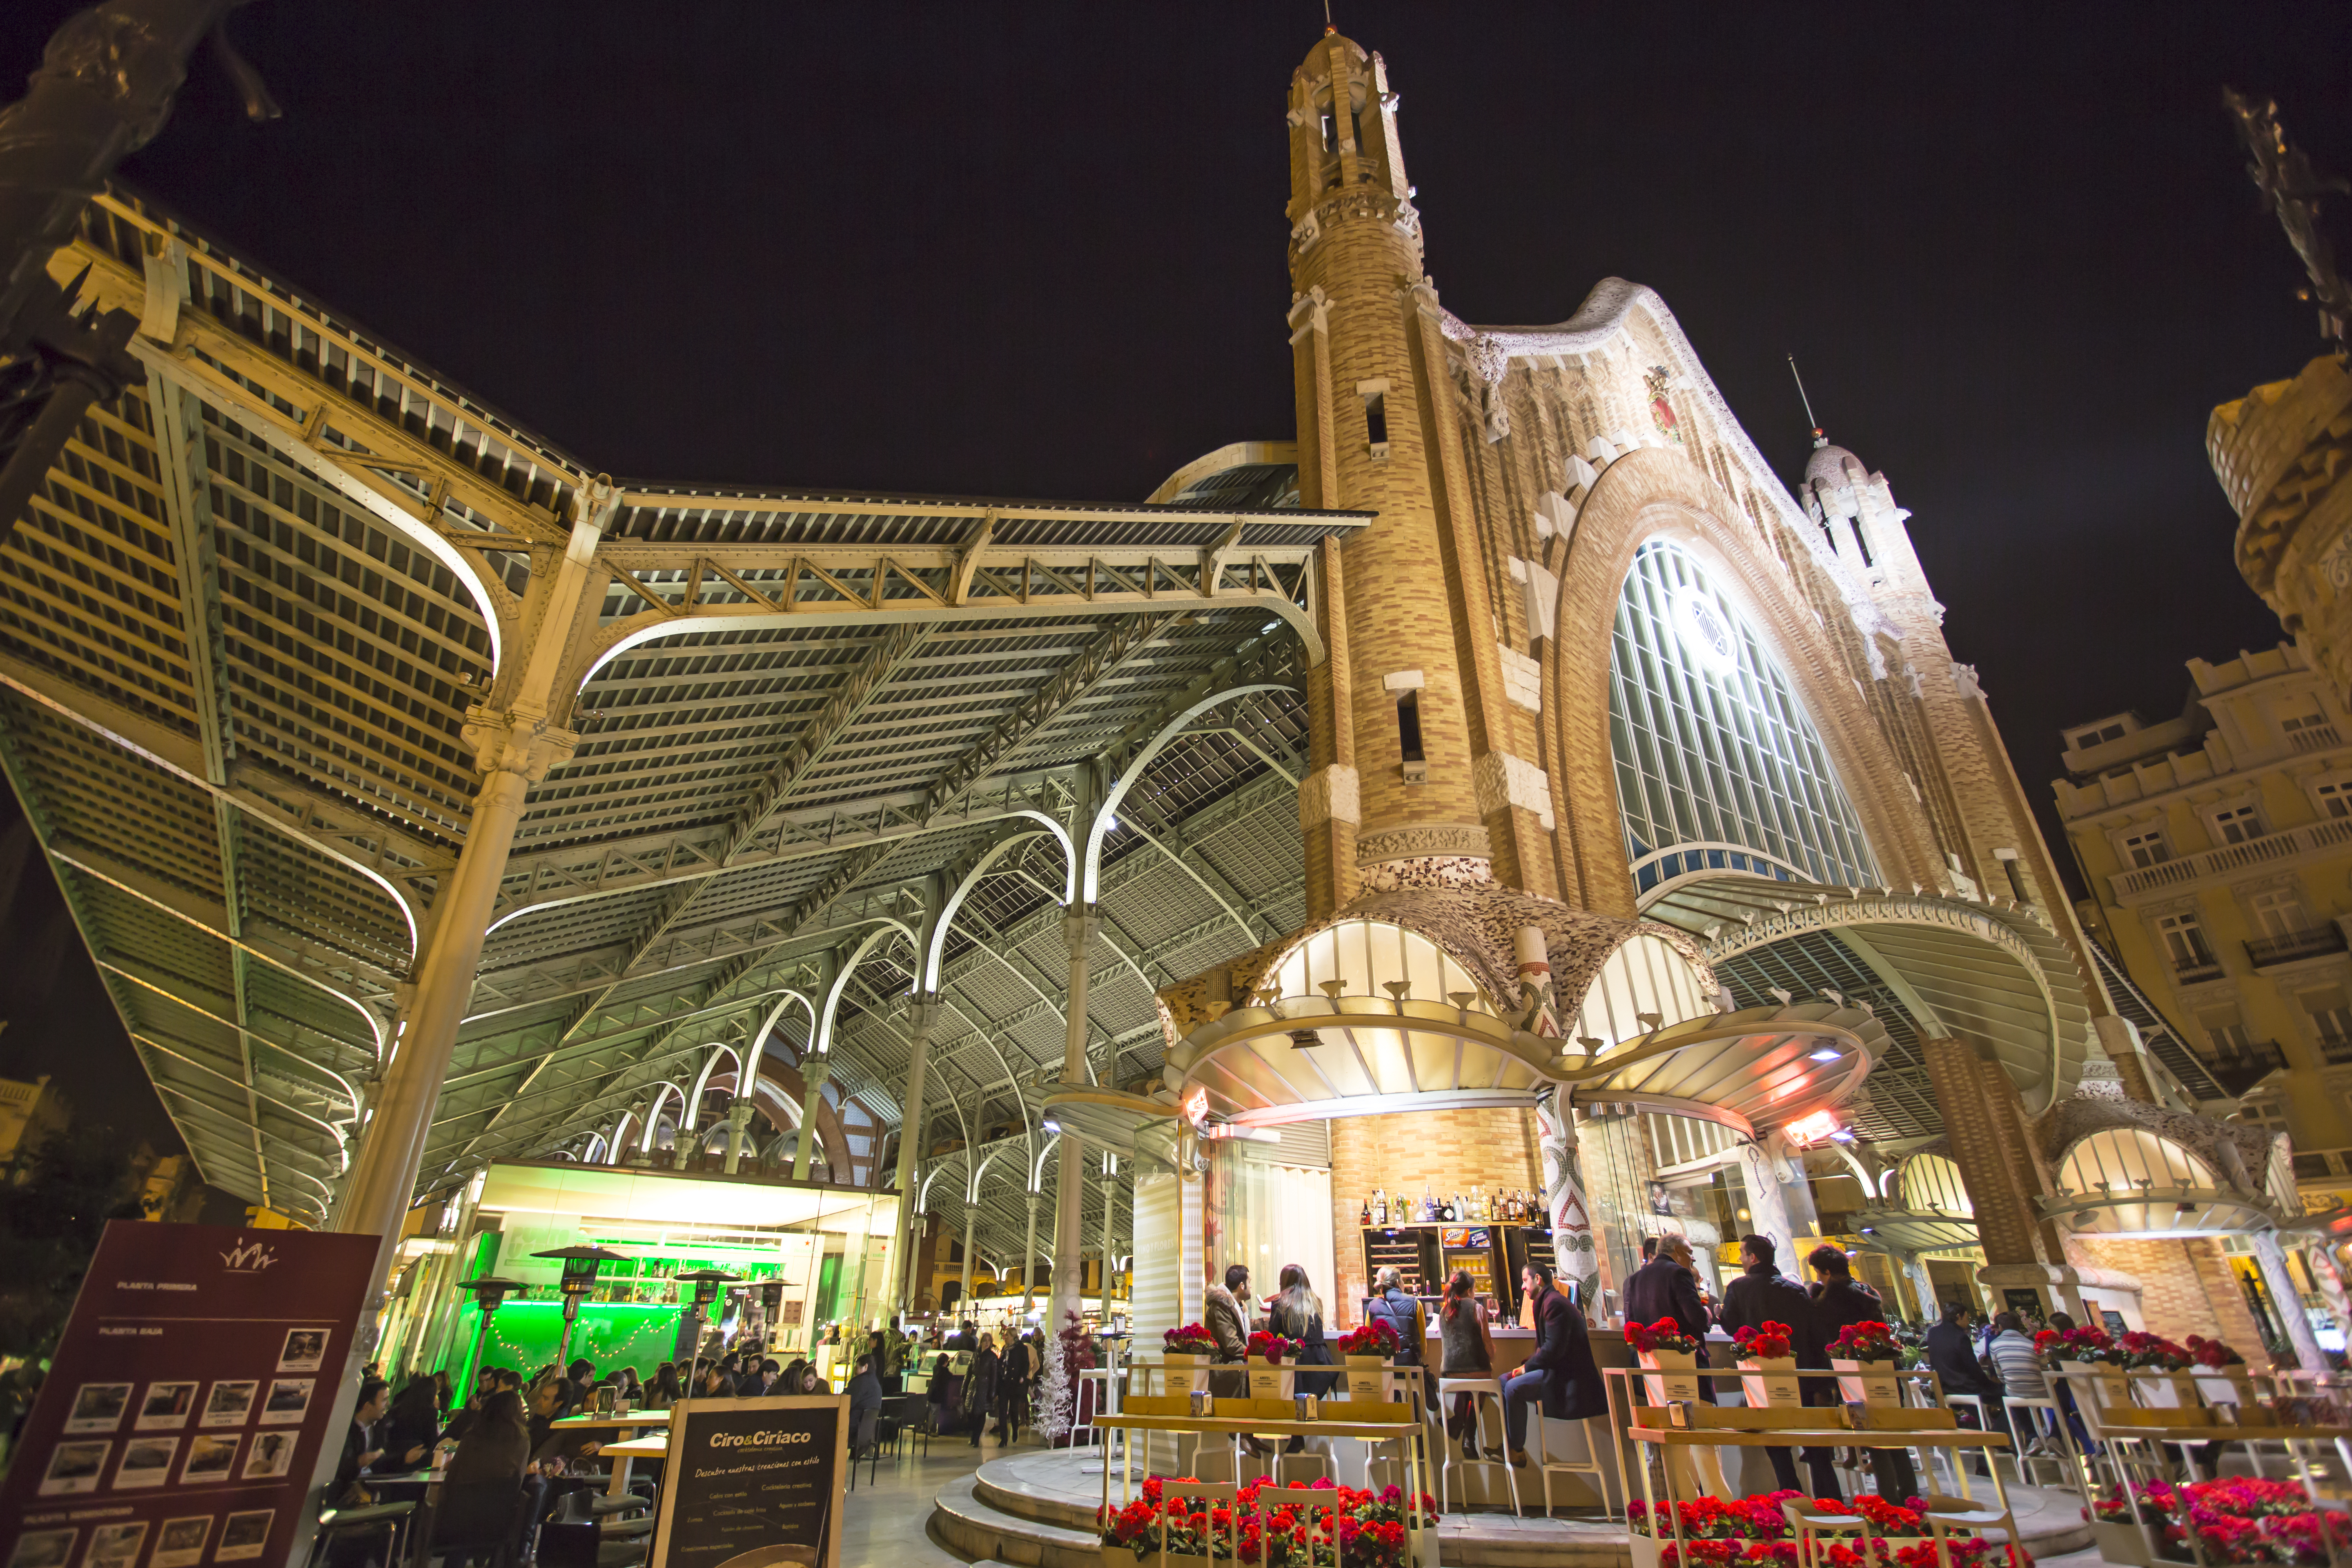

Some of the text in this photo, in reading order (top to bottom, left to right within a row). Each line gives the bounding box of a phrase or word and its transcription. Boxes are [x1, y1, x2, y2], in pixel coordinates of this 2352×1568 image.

[510, 1227, 570, 1245] PUNTO
[1445, 1228, 1465, 1241] Sunny
[1471, 1236, 1476, 1245] 5
[1136, 1238, 1174, 1254] VINO Y FLORES
[117, 1281, 197, 1291] PLANTA PRIMERA
[99, 1327, 137, 1335] PLANTA
[710, 1430, 811, 1448] Ciro&Ciriaco
[695, 1467, 725, 1478] Descubre
[728, 1464, 755, 1474] nuestras
[757, 1461, 789, 1471] creaciones
[804, 1455, 820, 1465] estilo
